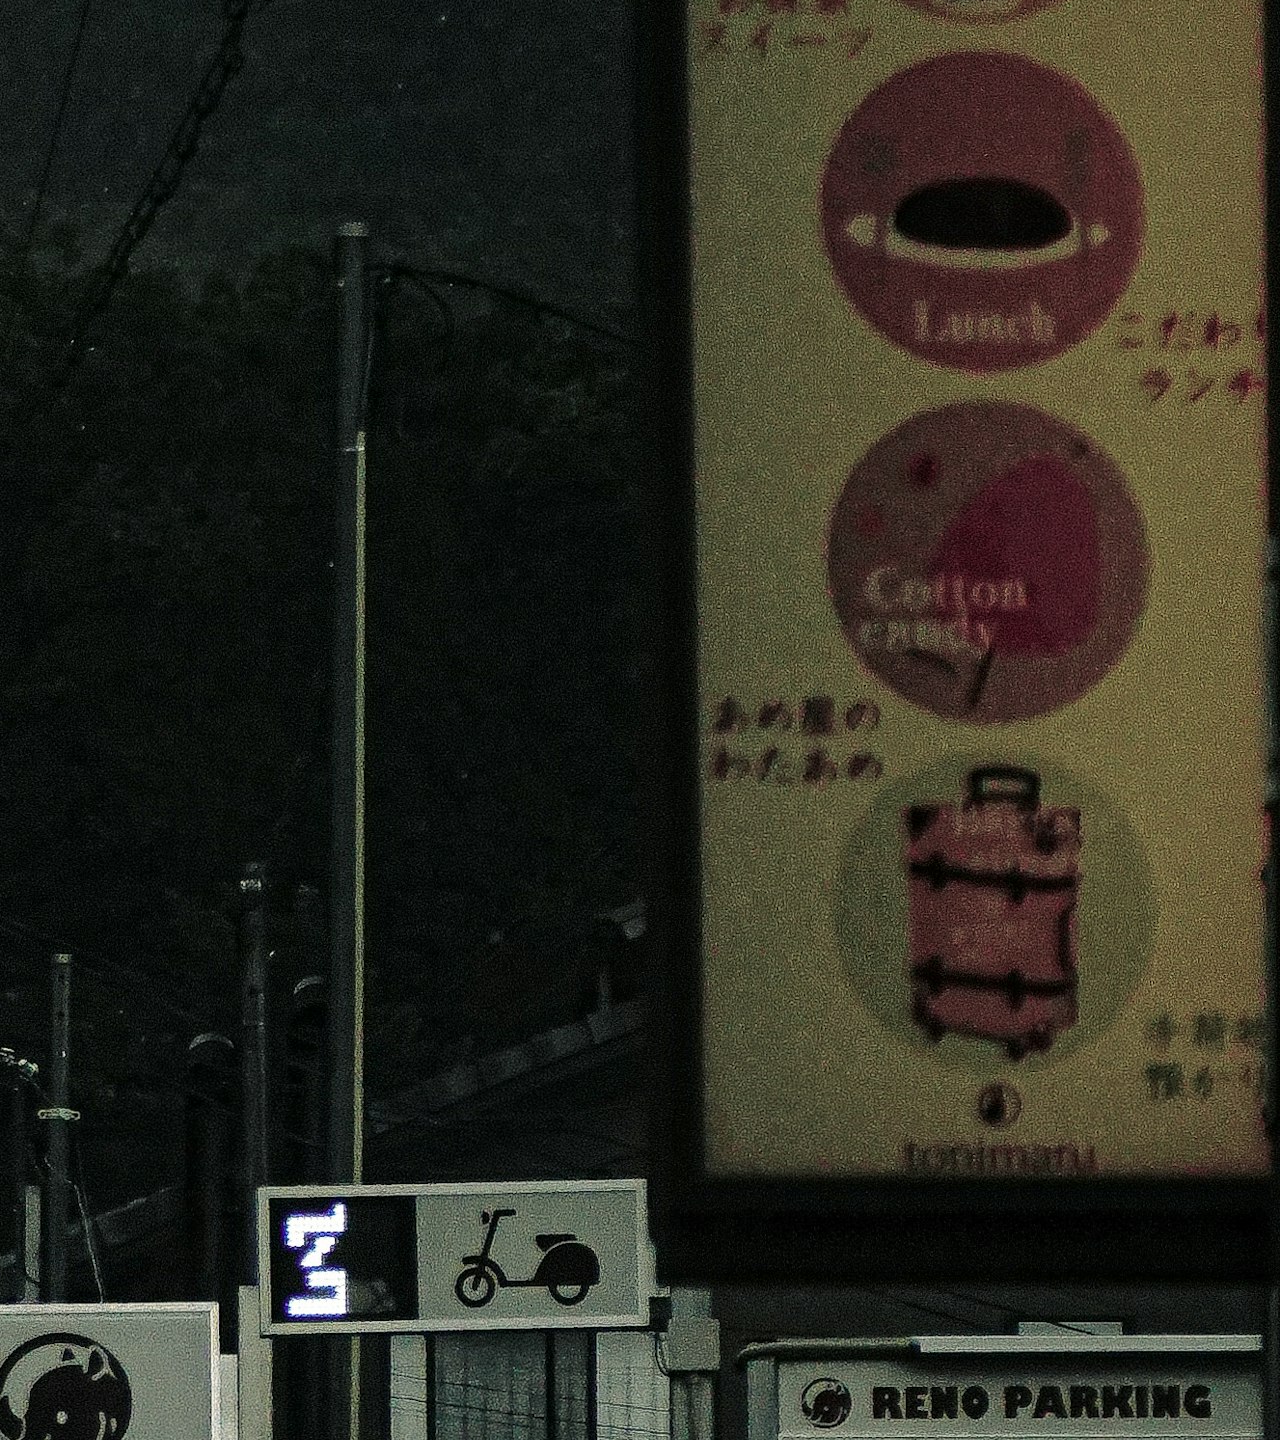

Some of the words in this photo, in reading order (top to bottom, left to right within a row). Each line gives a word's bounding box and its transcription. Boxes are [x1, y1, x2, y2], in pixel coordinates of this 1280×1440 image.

[914, 302, 1054, 342] Lunch
[865, 568, 1030, 611] Cotton
[872, 1385, 989, 1420] RENO
[1004, 1384, 1213, 1420] PARKING
